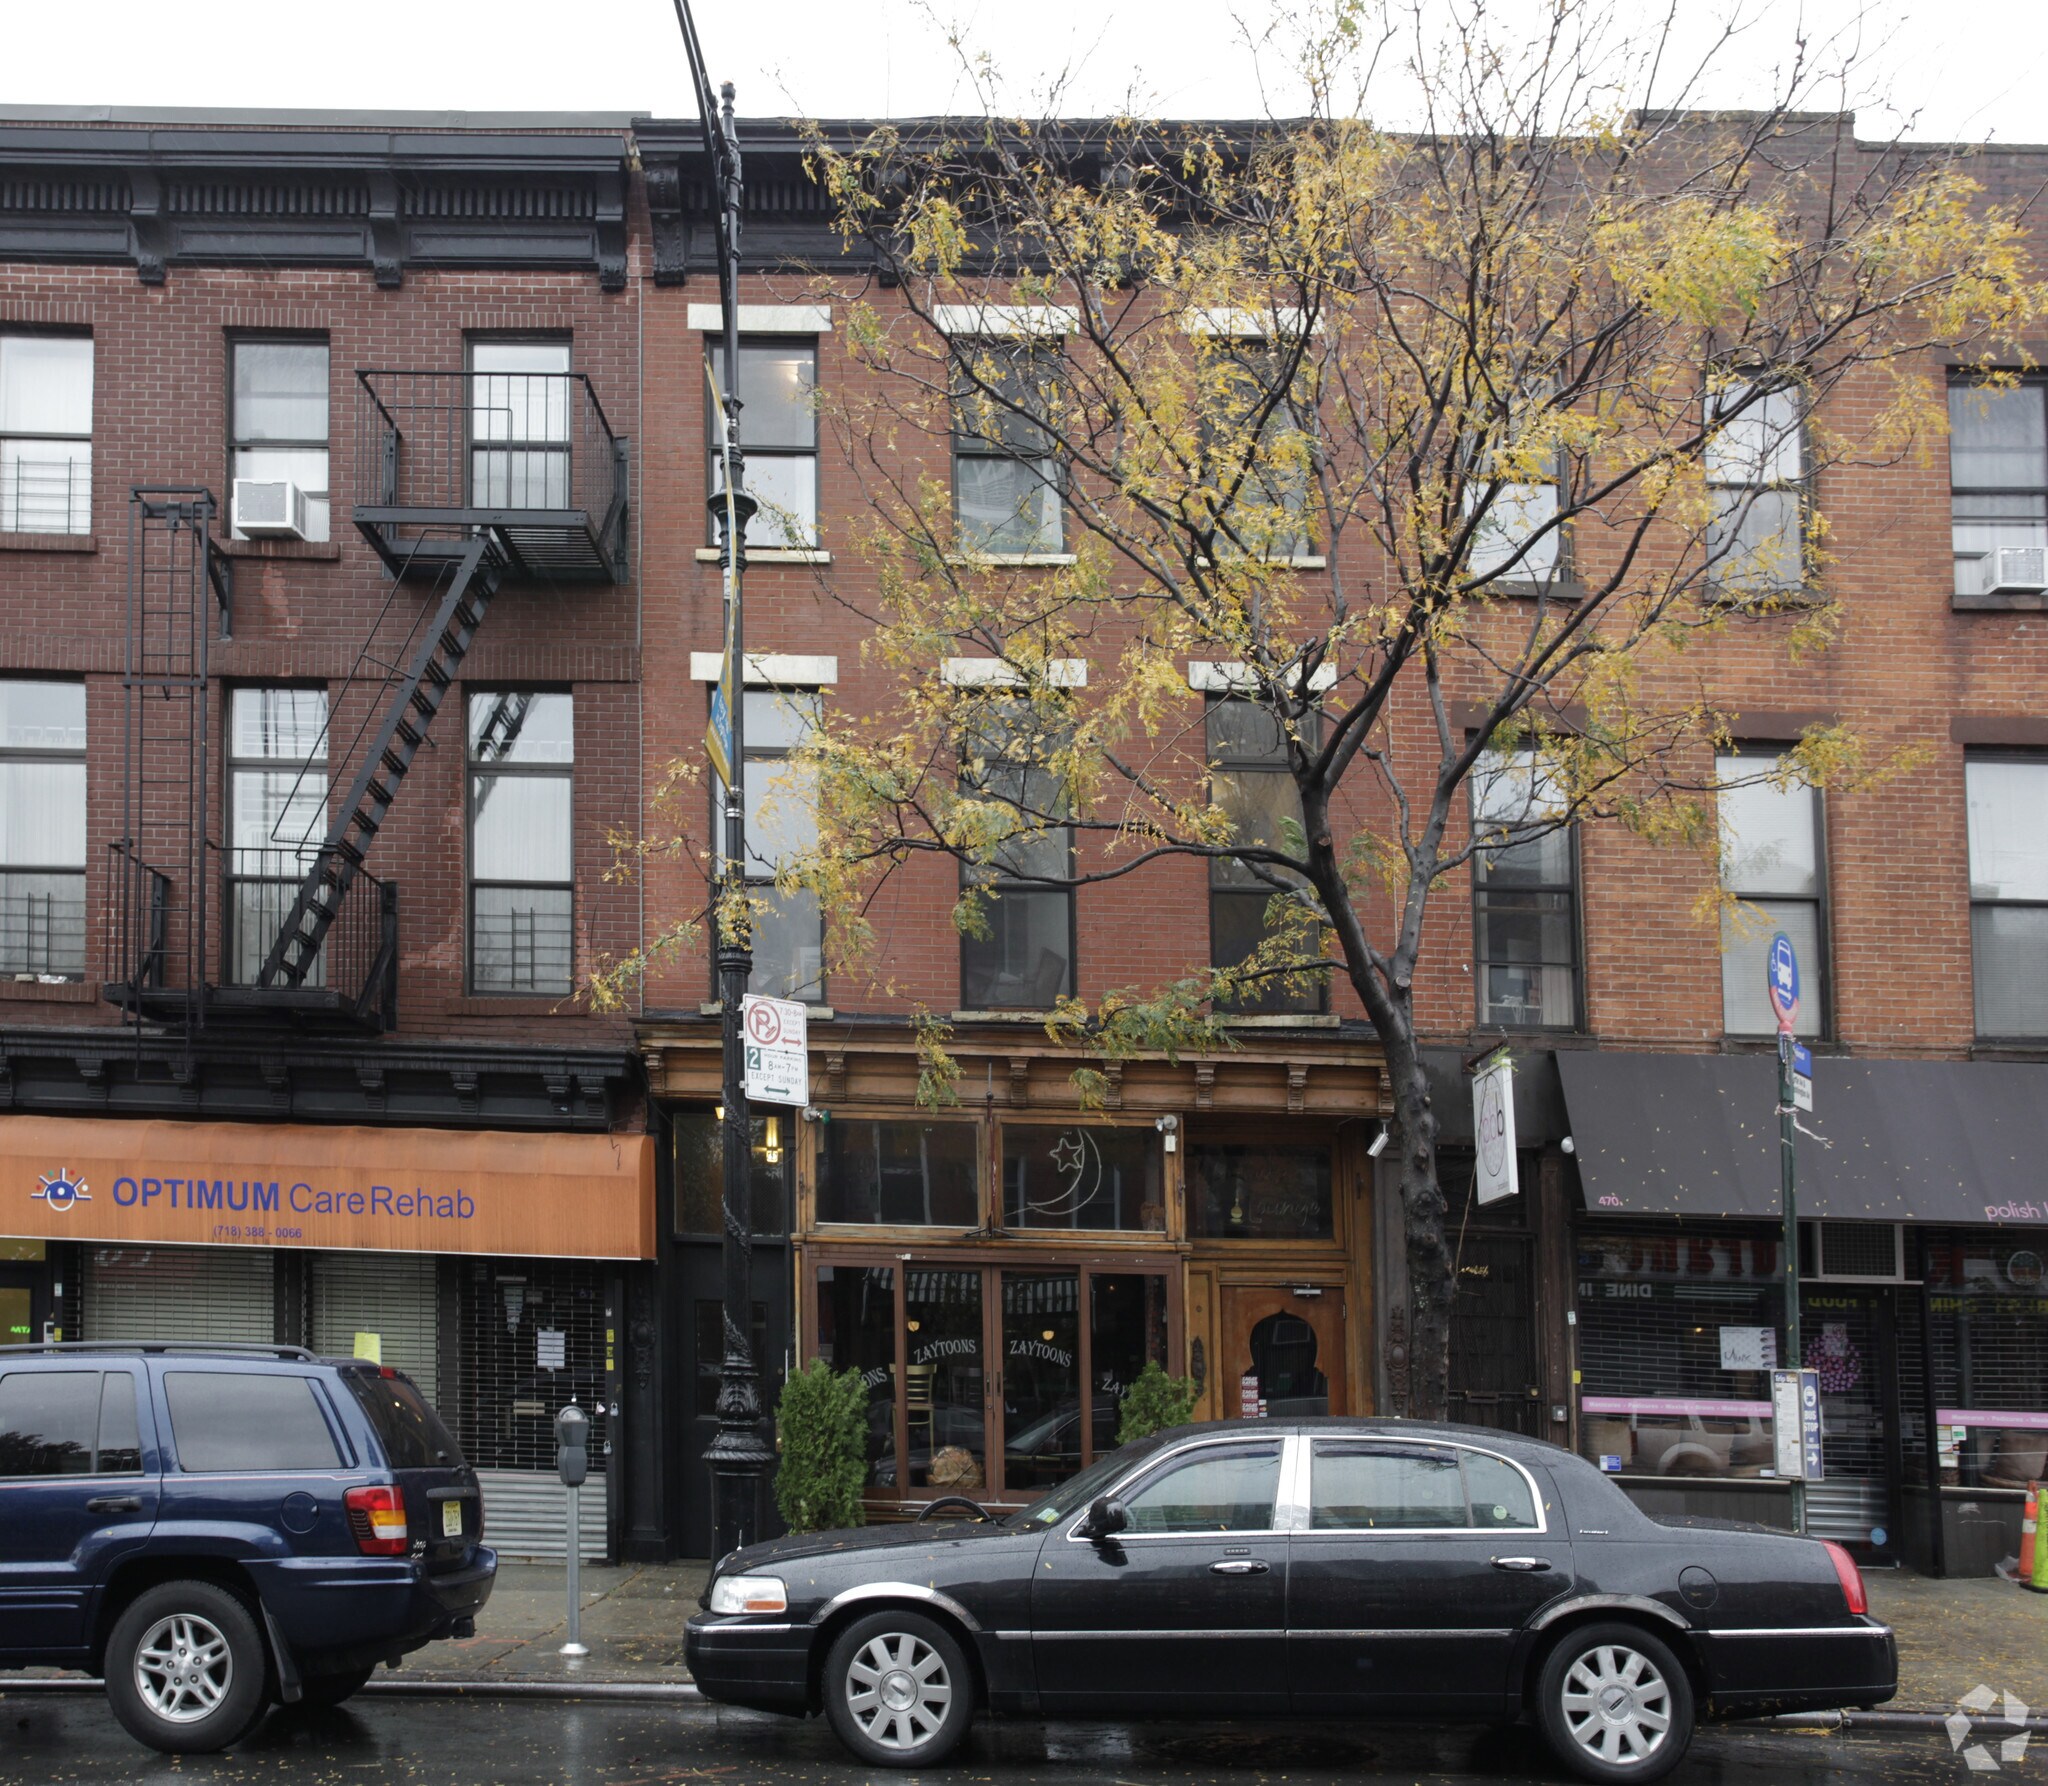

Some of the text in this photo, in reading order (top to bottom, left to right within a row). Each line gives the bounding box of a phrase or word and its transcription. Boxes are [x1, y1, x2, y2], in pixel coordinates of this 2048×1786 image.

[749, 1047, 759, 1069] 2
[751, 1071, 802, 1086] EXCEPT SUNDAY
[112, 1177, 279, 1211] OPTIMUM
[1598, 1196, 1620, 1207] 470
[1984, 1200, 2042, 1222] polish
[213, 1225, 242, 1238] (718)
[245, 1226, 265, 1237] 388
[275, 1227, 302, 1239] 0066
[913, 1339, 977, 1365] ZAYTOONS
[1009, 1340, 1072, 1368] ZAYTOONS
[1804, 1410, 1817, 1421] BUS
[1804, 1422, 1819, 1432] STOP
